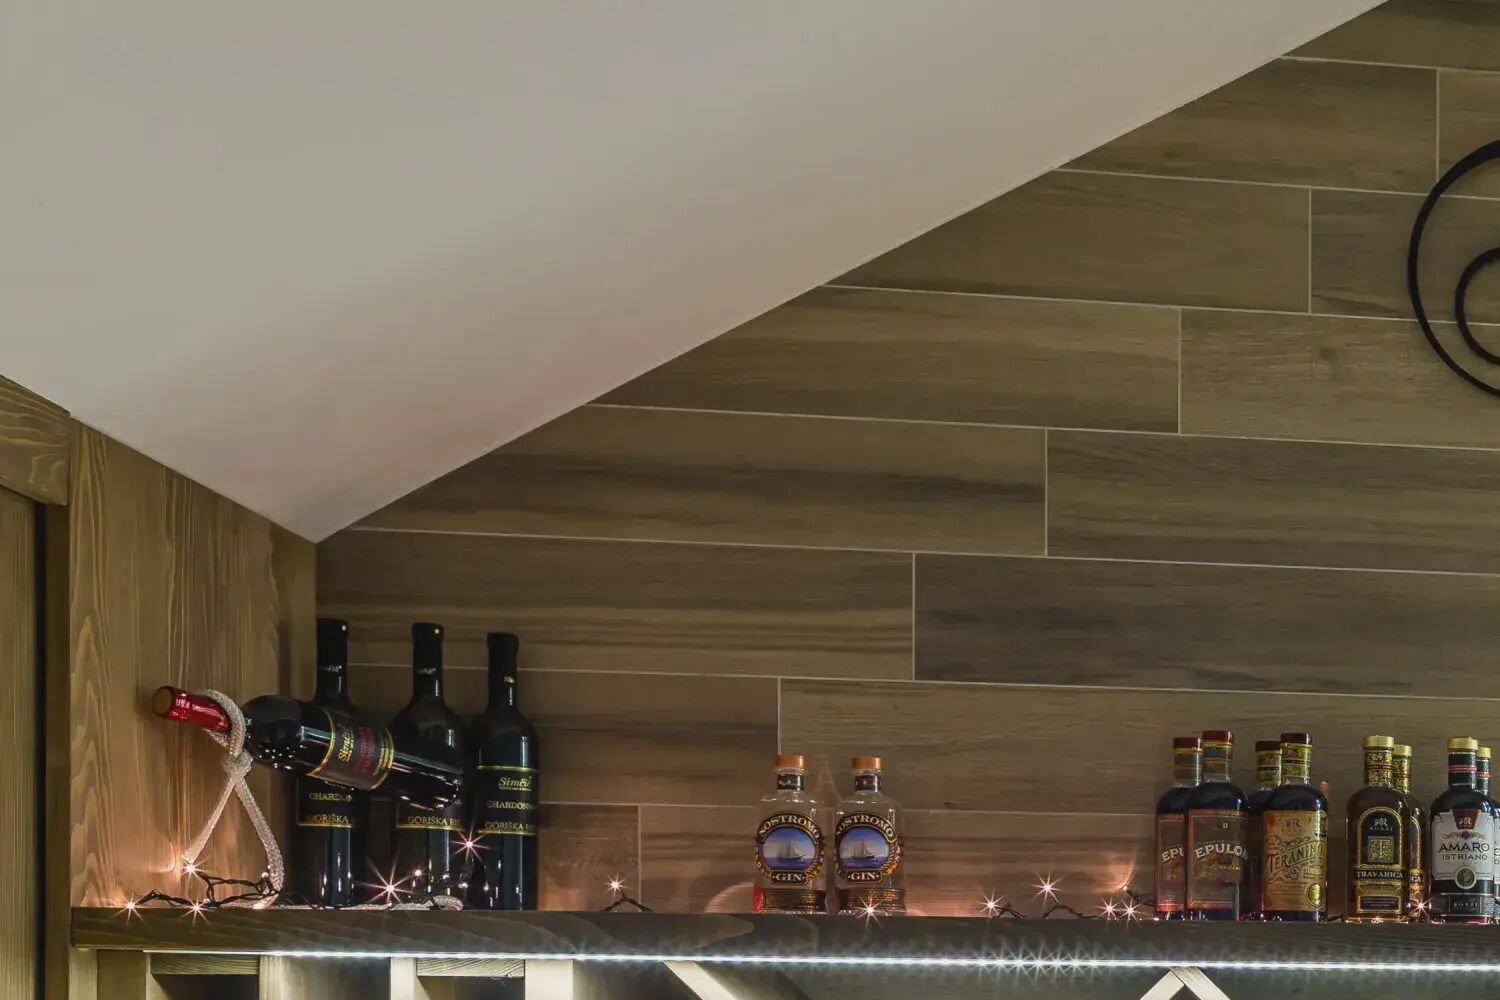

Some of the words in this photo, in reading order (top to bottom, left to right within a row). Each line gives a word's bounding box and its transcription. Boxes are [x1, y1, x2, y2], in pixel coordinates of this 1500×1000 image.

[759, 815, 821, 839] NOSTROMO
[1440, 842, 1490, 853] AMARO
[1442, 853, 1488, 861] ISTRIANO
[775, 872, 803, 881] GIN
[850, 872, 877, 881] GIN
